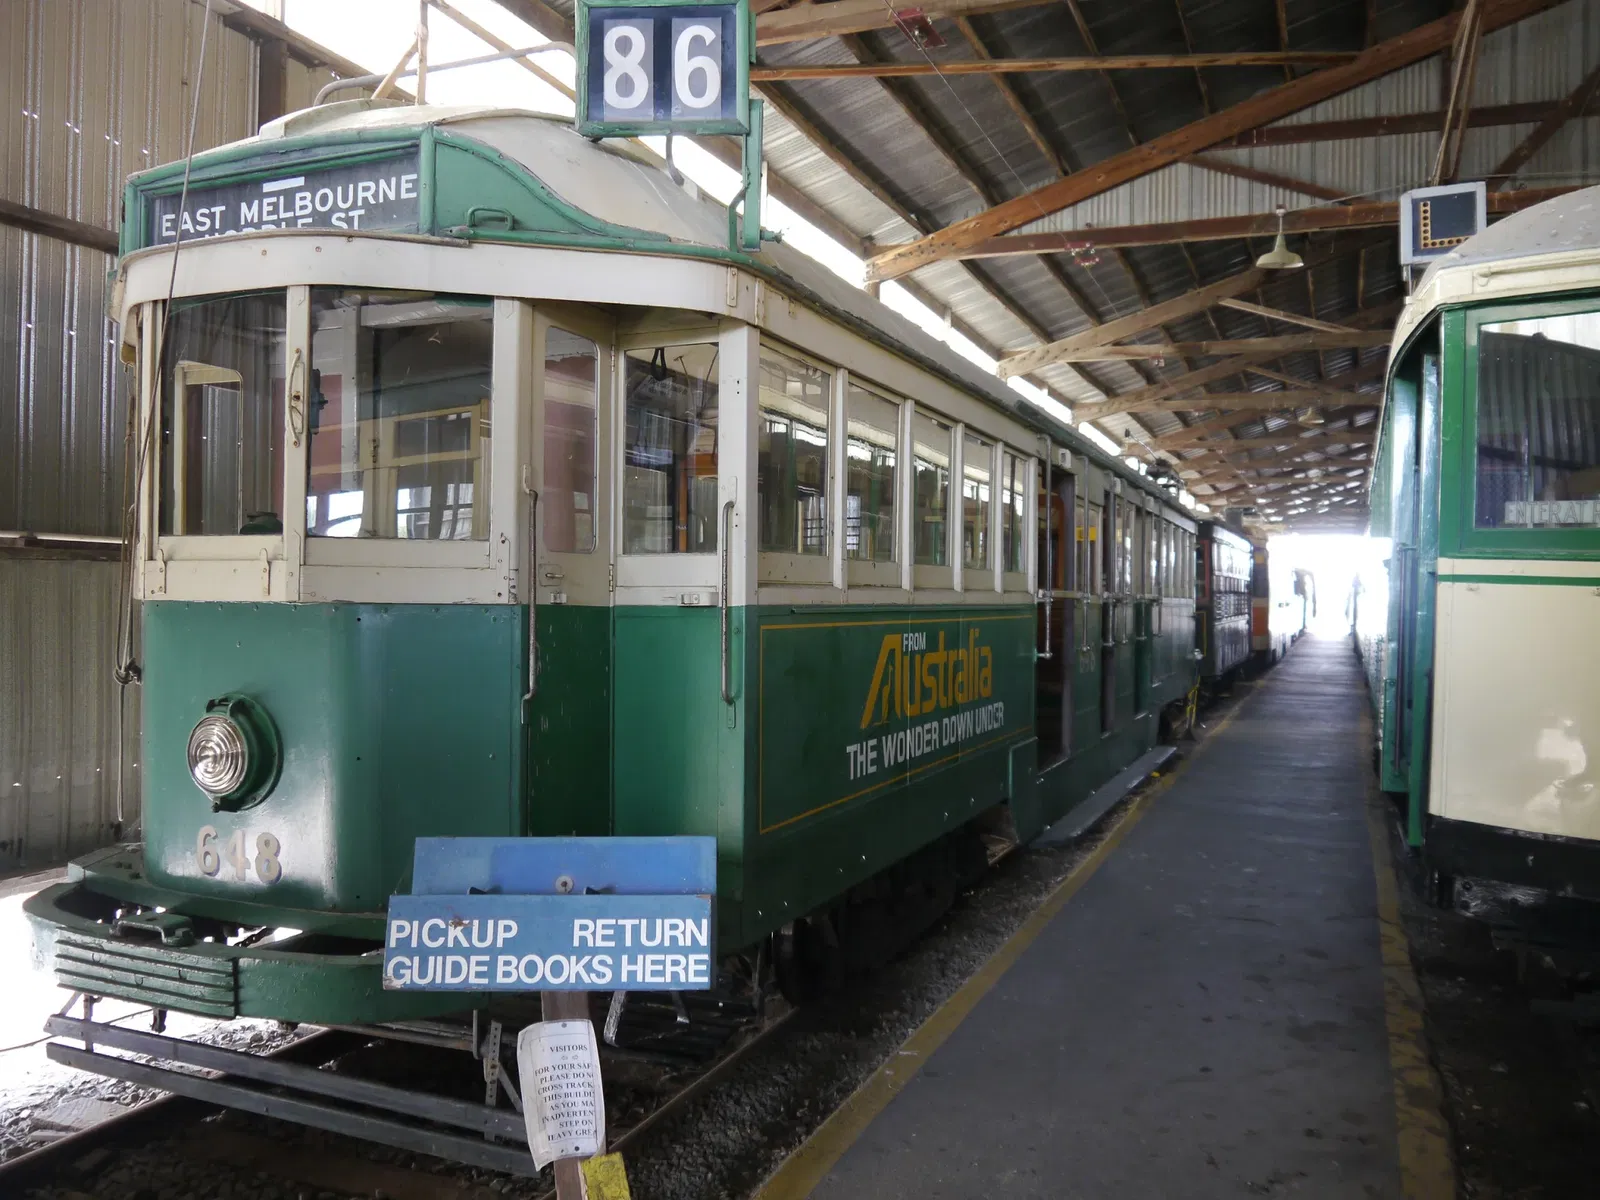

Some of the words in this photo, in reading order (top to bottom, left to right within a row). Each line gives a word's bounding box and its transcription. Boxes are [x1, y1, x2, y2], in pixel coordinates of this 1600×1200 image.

[604, 25, 721, 109] 86
[162, 206, 226, 237] EAST
[240, 174, 418, 226] MELBOURNE
[1505, 501, 1560, 524] ENTER
[1563, 501, 1588, 524] AT
[903, 632, 926, 652] FROM
[860, 628, 992, 729] Australia
[846, 738, 878, 780] THE
[882, 720, 939, 768] WONDER
[942, 710, 974, 747] DOWN
[975, 701, 1004, 735] UNDER
[196, 825, 282, 885] 648
[389, 918, 519, 948] PICKUP
[572, 918, 708, 948] RETURN
[387, 955, 490, 985] GUIDE
[496, 954, 613, 984] BOOKS
[621, 954, 709, 983] HERE
[549, 1044, 588, 1053] VISITORS
[535, 1066, 550, 1077] FOR
[551, 1063, 576, 1071] YOUR
[540, 1073, 571, 1084] PLEASE
[538, 1084, 563, 1096] CROSS
[543, 1093, 562, 1103] THIS
[550, 1102, 560, 1111] AS
[561, 1100, 578, 1109] YOU
[559, 1119, 580, 1129] STEP
